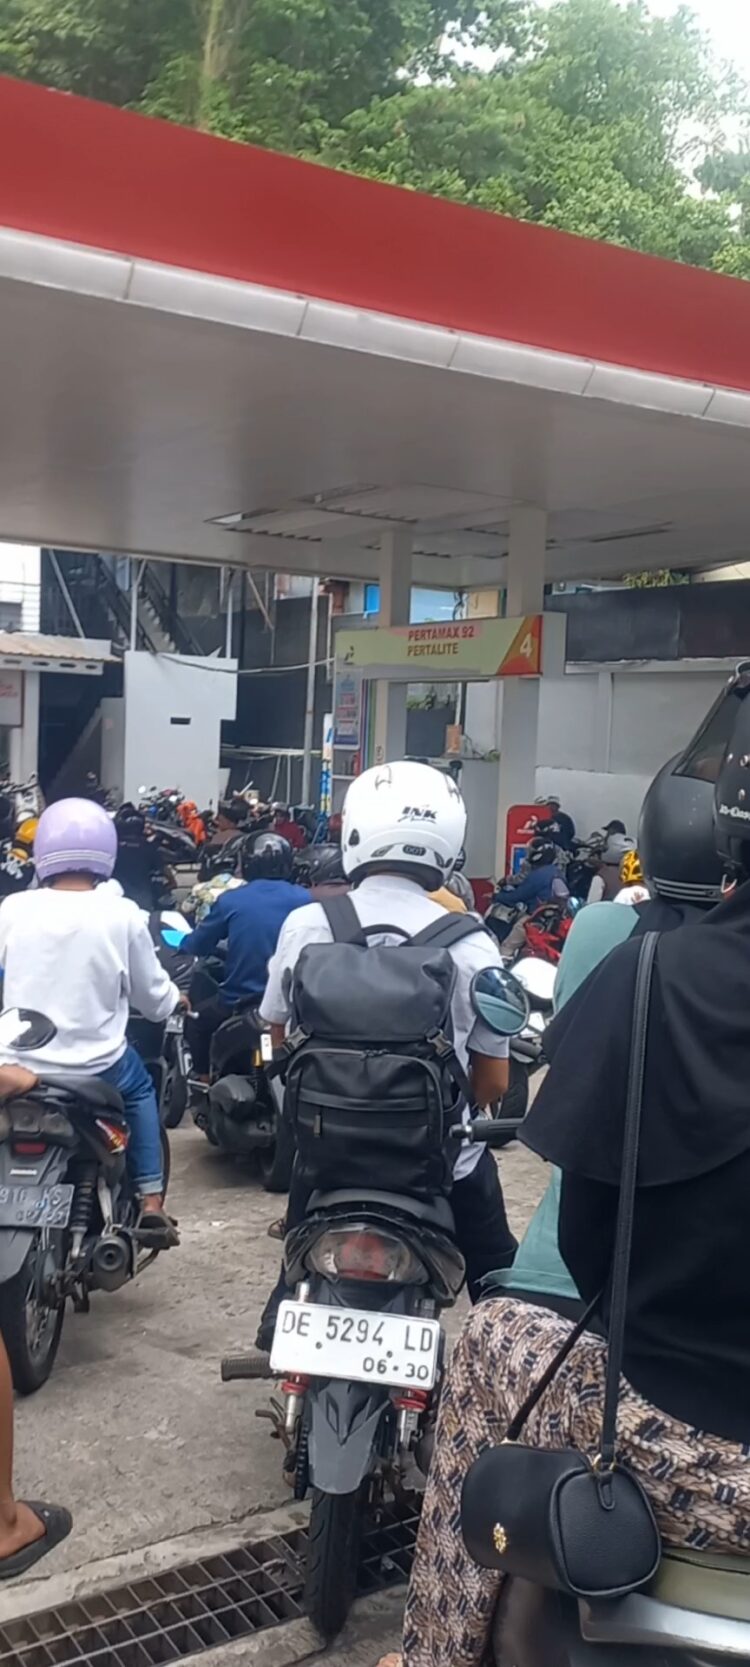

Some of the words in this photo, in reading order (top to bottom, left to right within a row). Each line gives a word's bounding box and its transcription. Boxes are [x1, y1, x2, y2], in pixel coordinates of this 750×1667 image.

[408, 627, 460, 641] PERTAMAX
[461, 625, 475, 639] 92
[407, 642, 459, 657] PERTALITE
[519, 632, 533, 658] 4
[401, 806, 438, 819] INK
[281, 1310, 312, 1336] DE
[325, 1315, 385, 1346] 5294
[404, 1324, 434, 1353] LD
